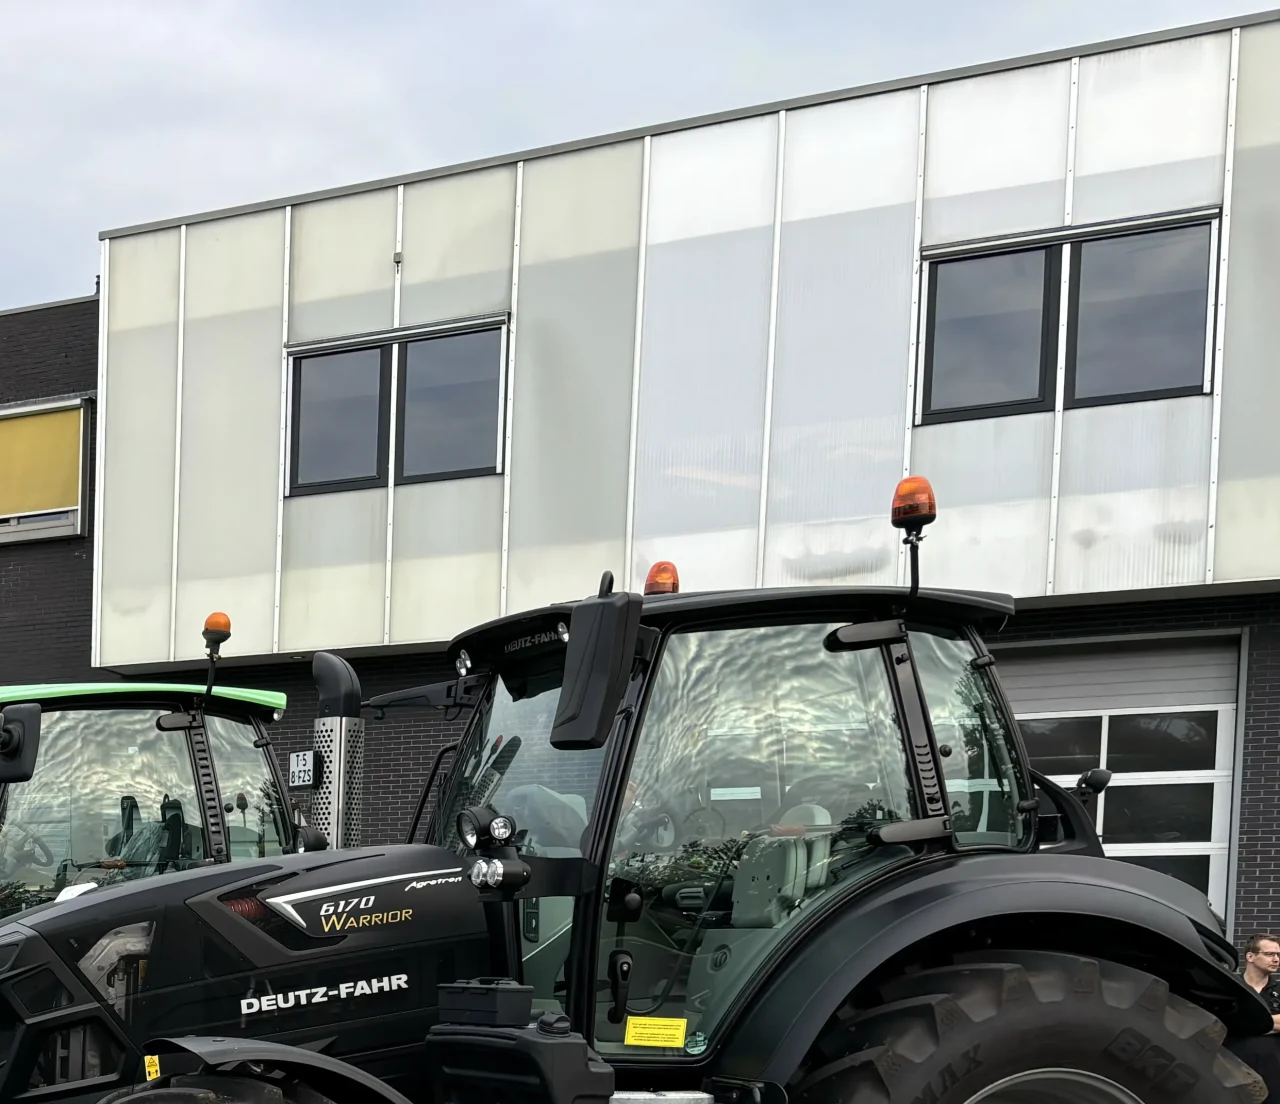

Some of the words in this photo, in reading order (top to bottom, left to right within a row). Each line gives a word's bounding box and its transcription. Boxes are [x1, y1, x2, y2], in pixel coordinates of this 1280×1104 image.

[504, 631, 558, 653] DEUTZ-FAH
[405, 876, 462, 892] Agrotron
[320, 896, 375, 916] 6170
[241, 973, 409, 1014] DEUTZ-FAHR
